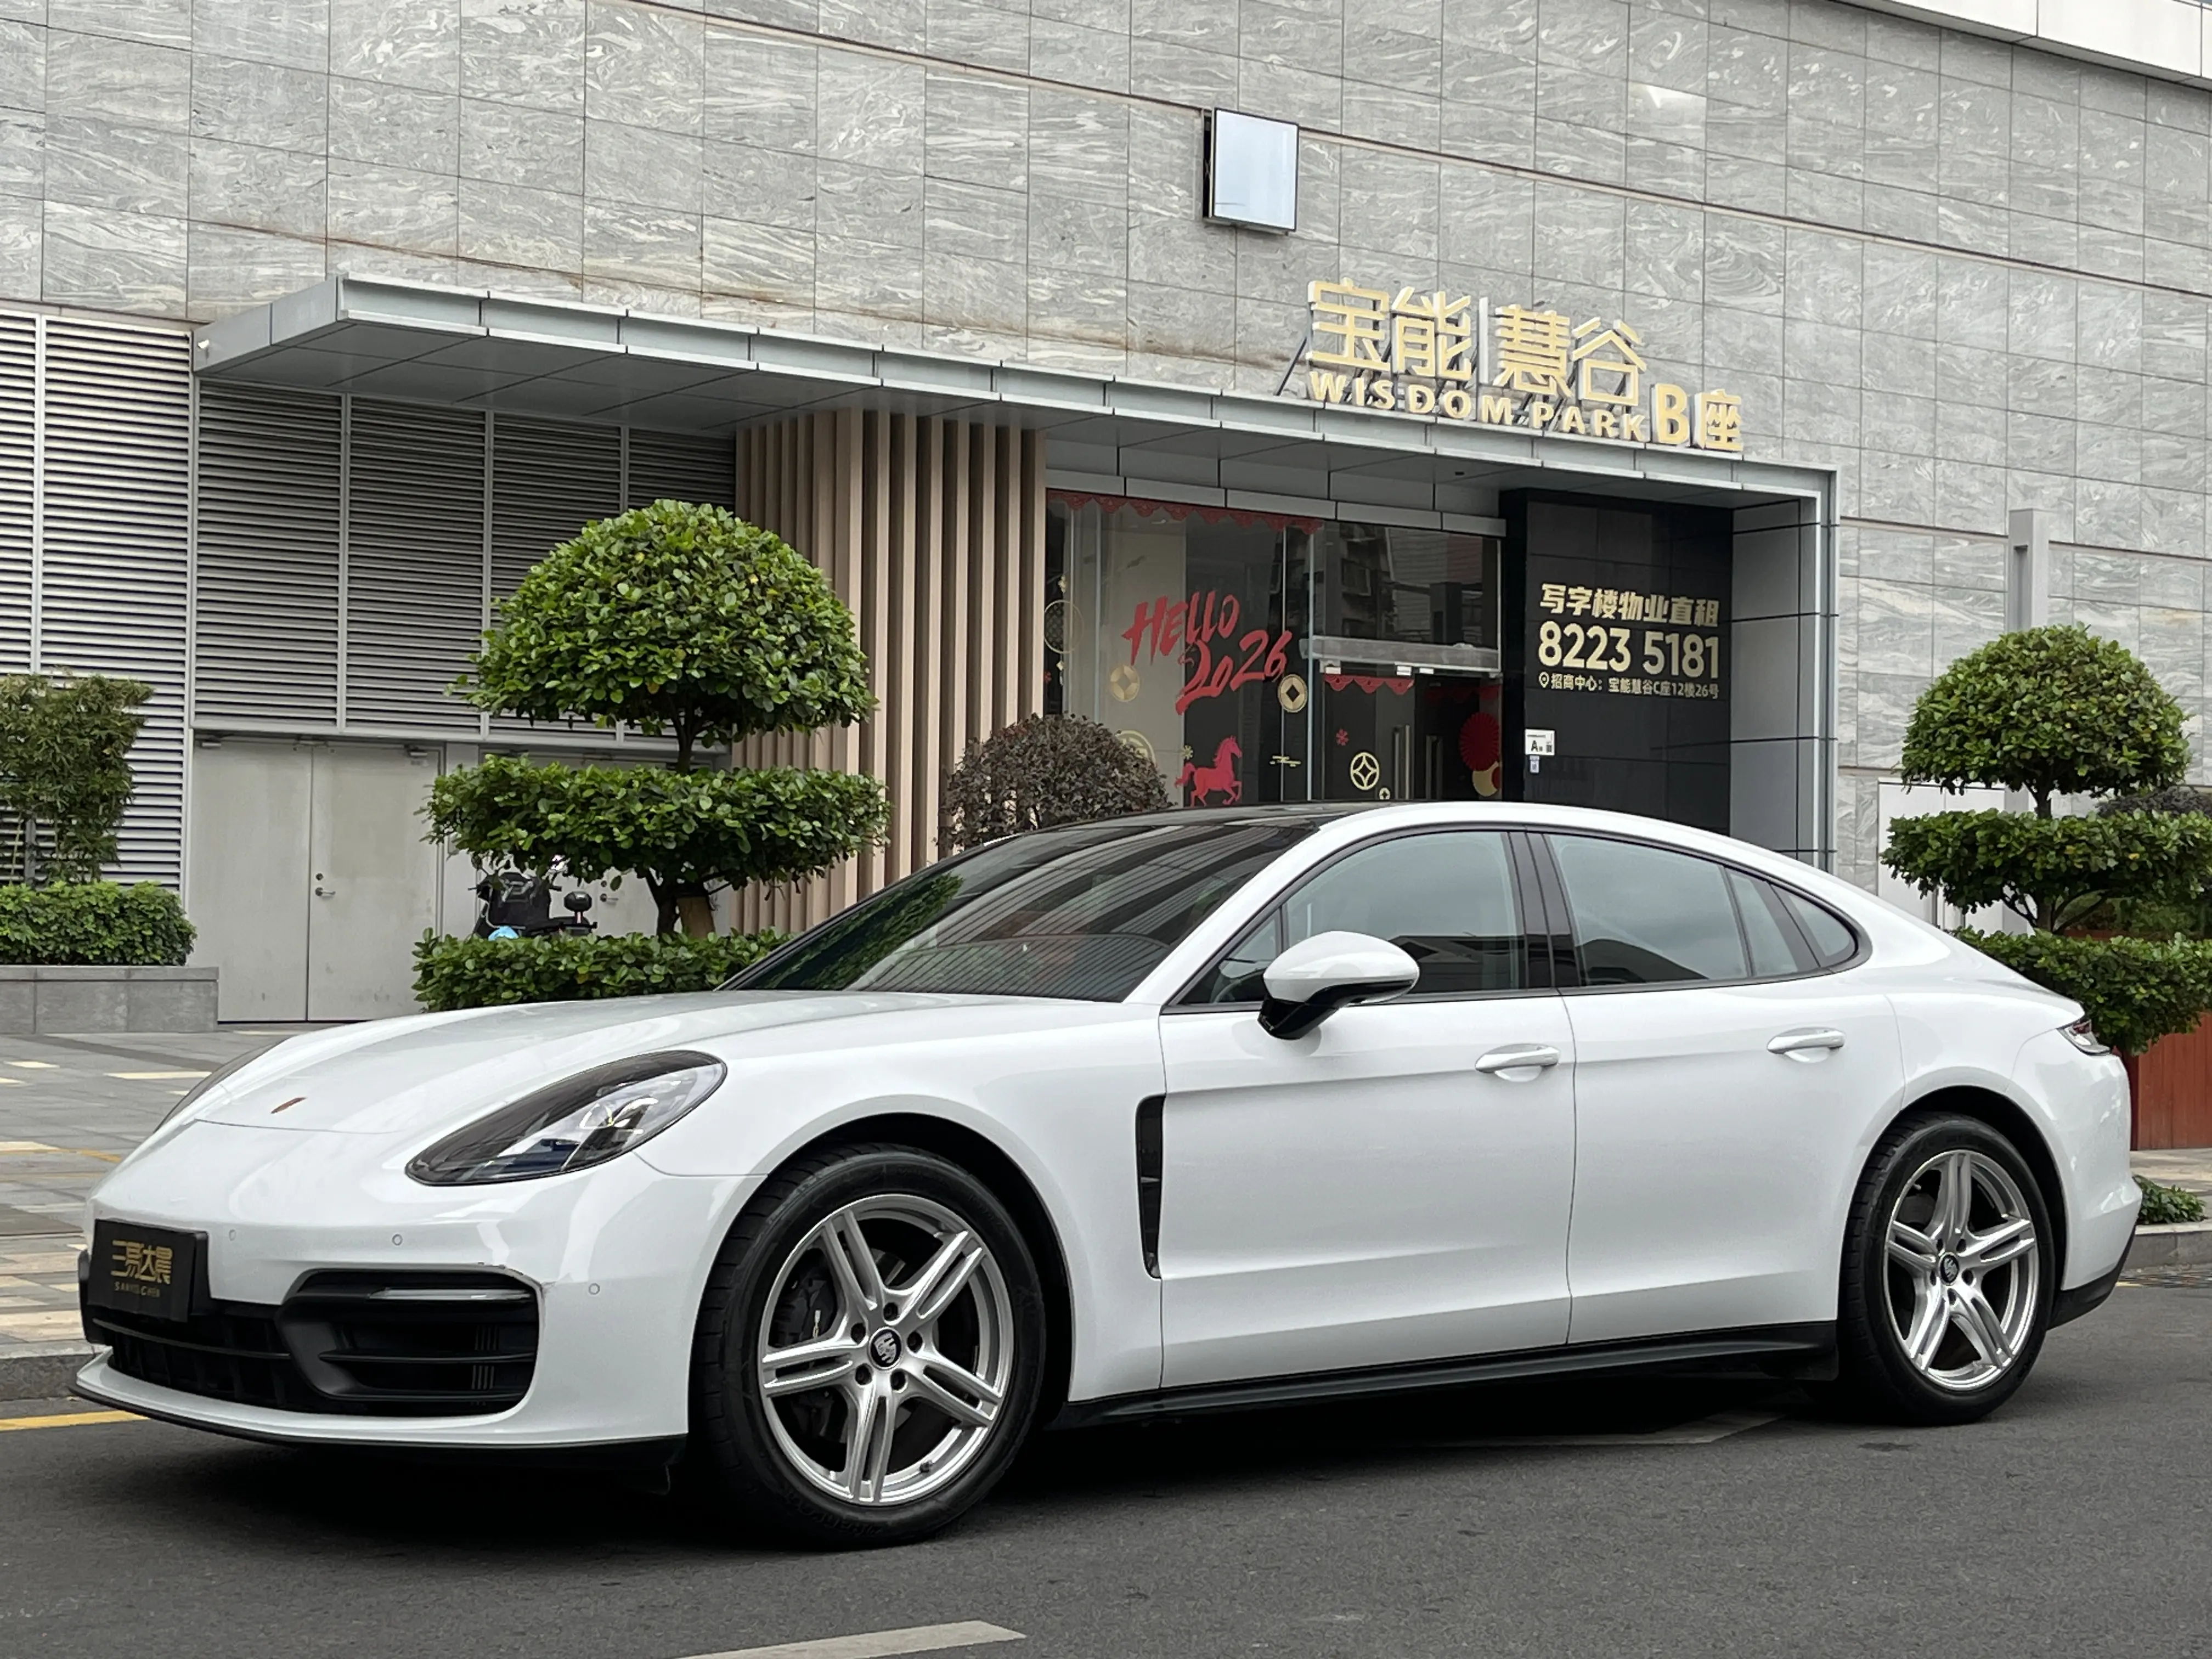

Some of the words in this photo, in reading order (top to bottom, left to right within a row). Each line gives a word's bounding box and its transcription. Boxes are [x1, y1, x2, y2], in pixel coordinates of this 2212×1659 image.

[1308, 371, 1515, 426] WISDOM
[1530, 401, 1646, 442] PARK
[1650, 382, 1743, 452] B座
[1121, 590, 1240, 665] HELLO
[1539, 583, 1720, 628] 写字楼物业直租
[1175, 629, 1293, 715] 2026
[1538, 620, 1632, 673] 8223
[1643, 630, 1719, 679] 5181
